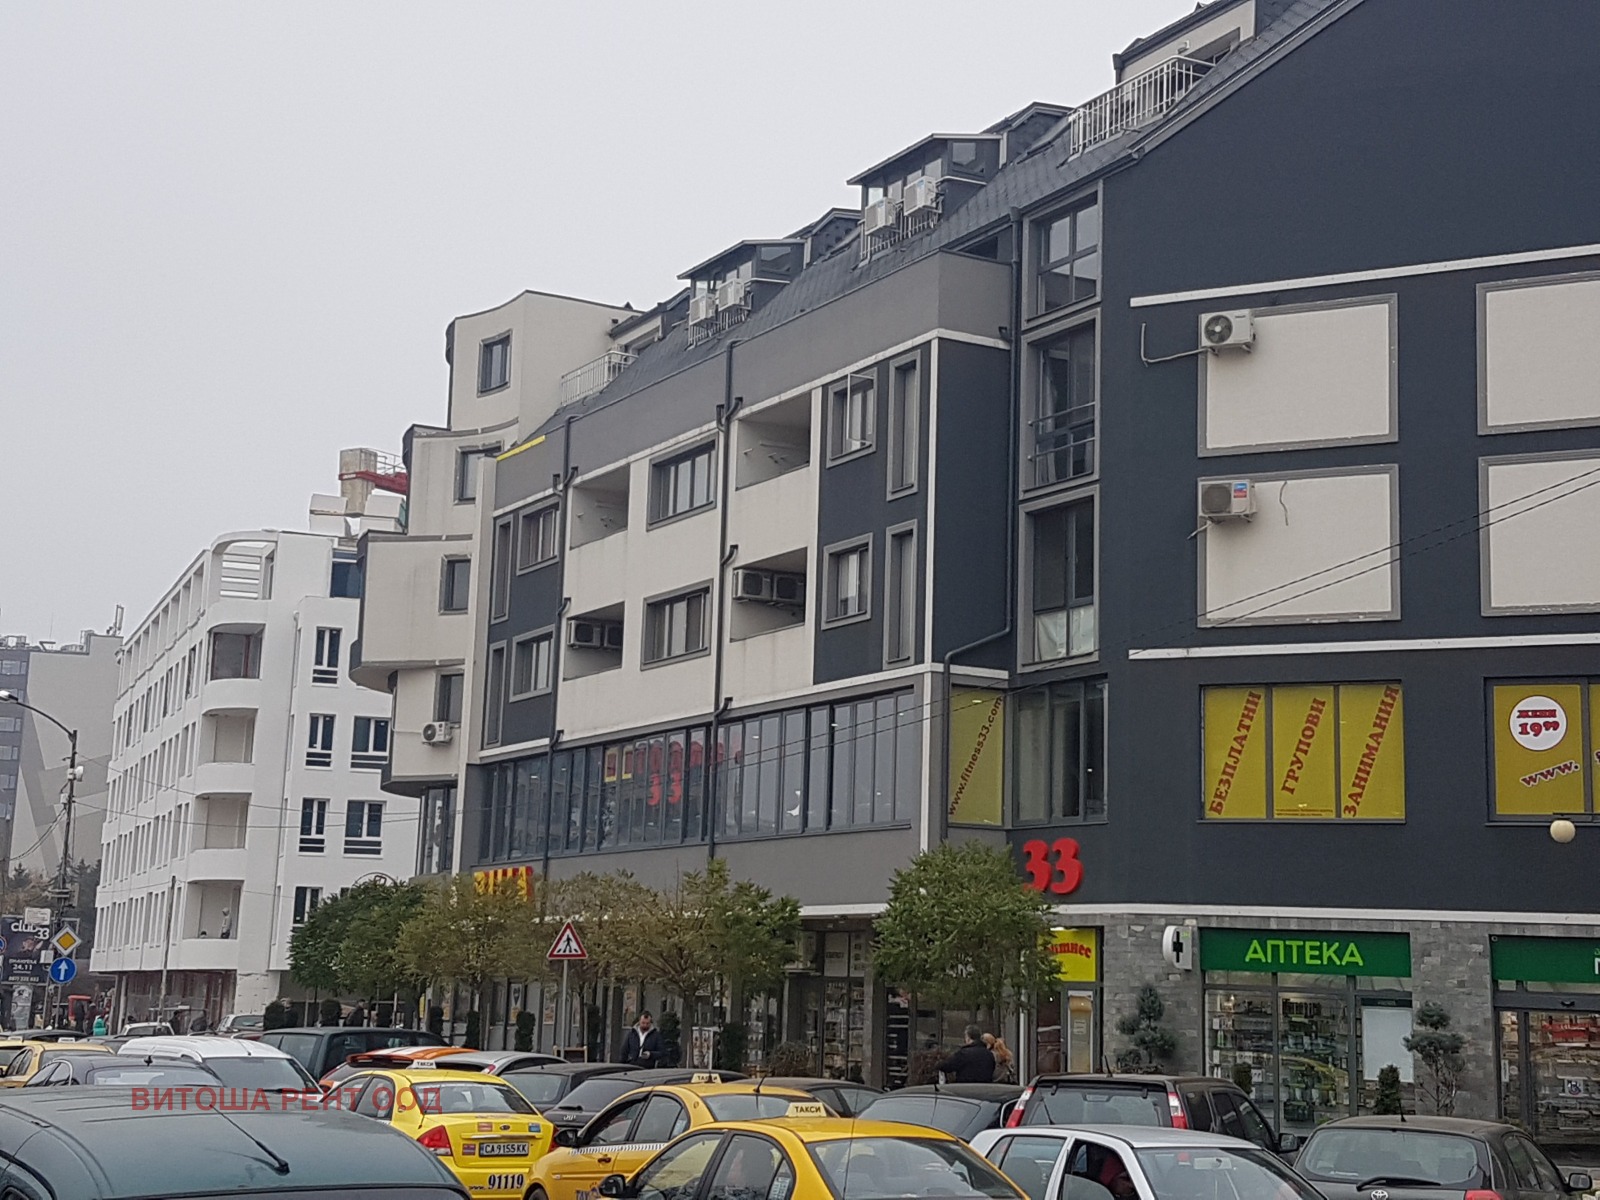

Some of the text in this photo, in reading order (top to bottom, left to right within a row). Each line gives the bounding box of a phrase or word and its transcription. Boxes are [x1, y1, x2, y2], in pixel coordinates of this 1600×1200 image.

[948, 694, 1004, 816] www.fitness33.com
[1208, 690, 1262, 815] БЕЗПЛАТНИ
[1281, 697, 1327, 796] ГРУПОВИ
[1343, 685, 1400, 818] ЗАНИМАНИЯ
[1022, 838, 1083, 894] 33
[1244, 939, 1364, 967] АПТЕКА
[488, 1174, 524, 1190] 91119
